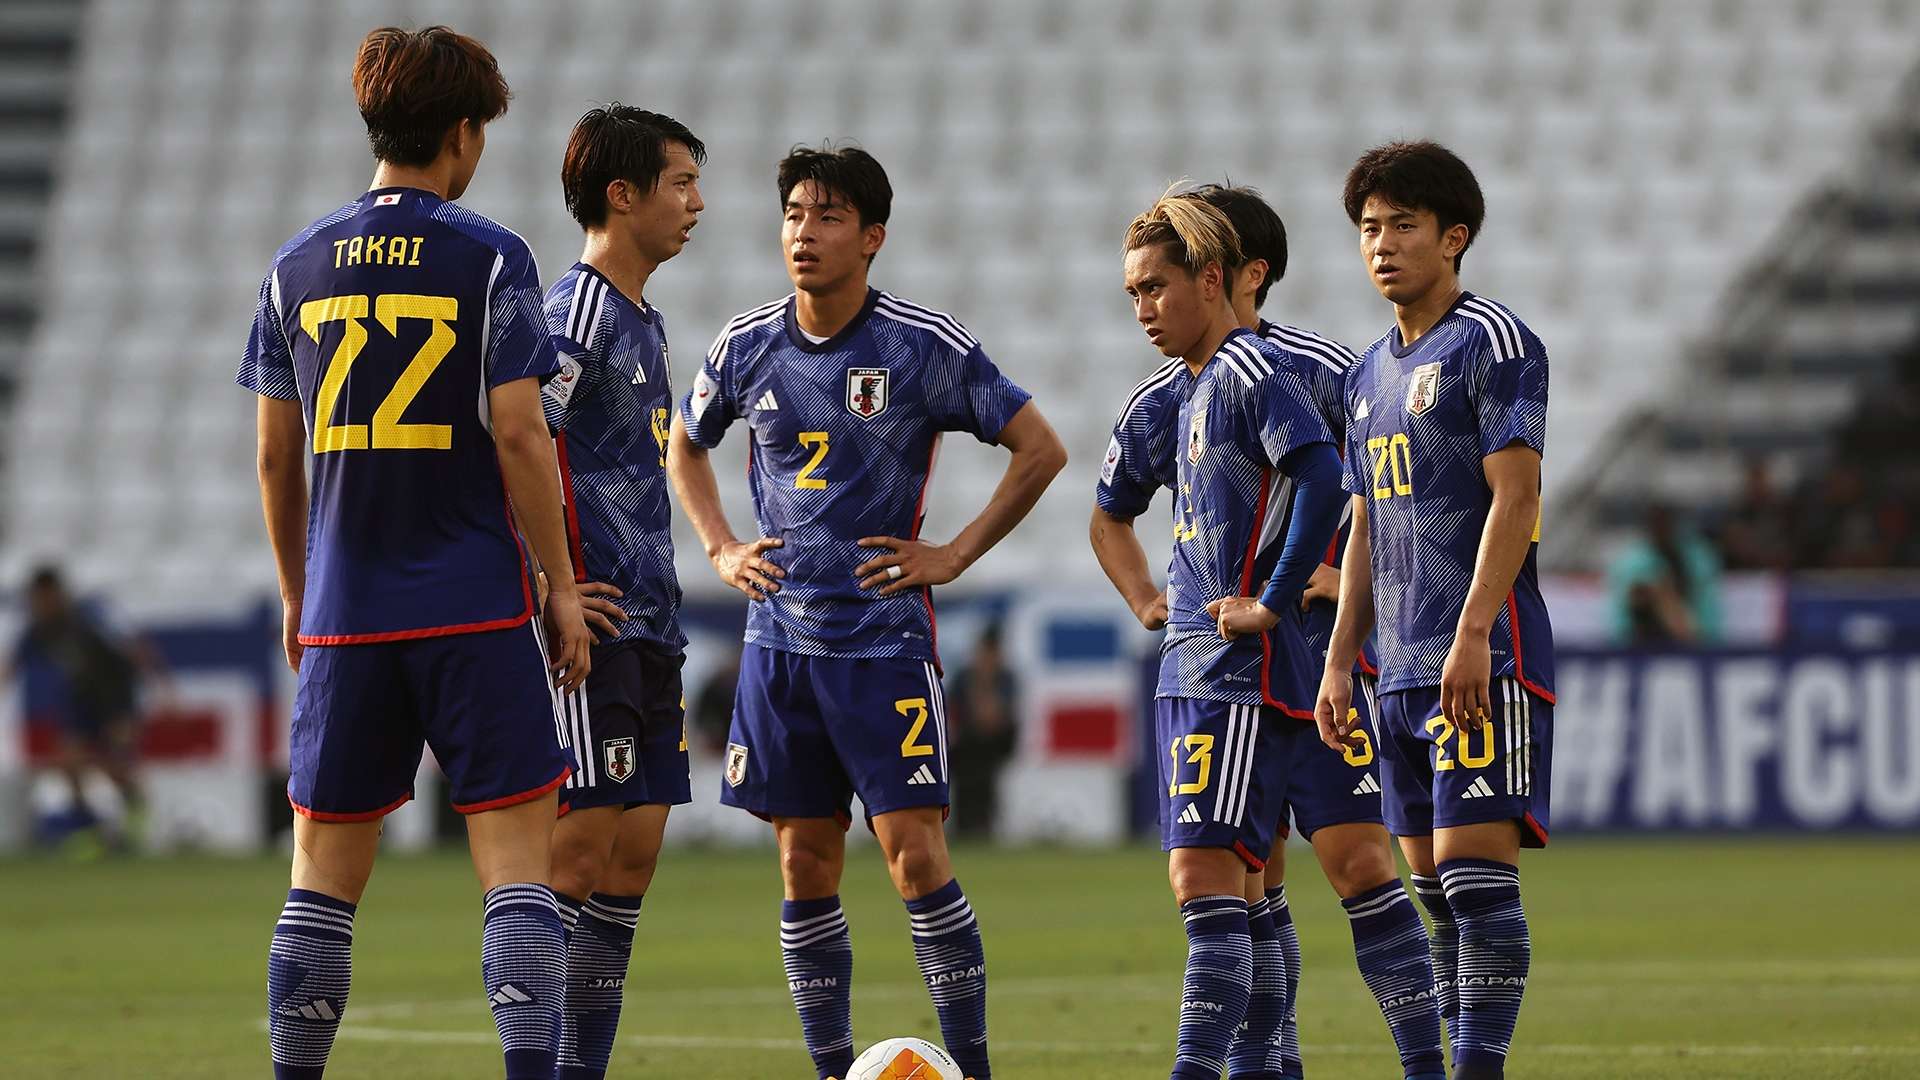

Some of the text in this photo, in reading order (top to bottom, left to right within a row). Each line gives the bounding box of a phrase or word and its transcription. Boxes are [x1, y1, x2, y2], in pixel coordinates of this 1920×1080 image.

[333, 235, 424, 268] TAKAI
[300, 294, 459, 454] 22
[795, 431, 829, 490] 2
[1367, 432, 1413, 501] 20
[895, 697, 934, 757] 2
[1424, 707, 1495, 772] 20
[1169, 734, 1215, 798] 13
[925, 964, 985, 986] JAPAN
[1382, 986, 1437, 1012] JAPAN
[1458, 976, 1528, 987] JAPAN
